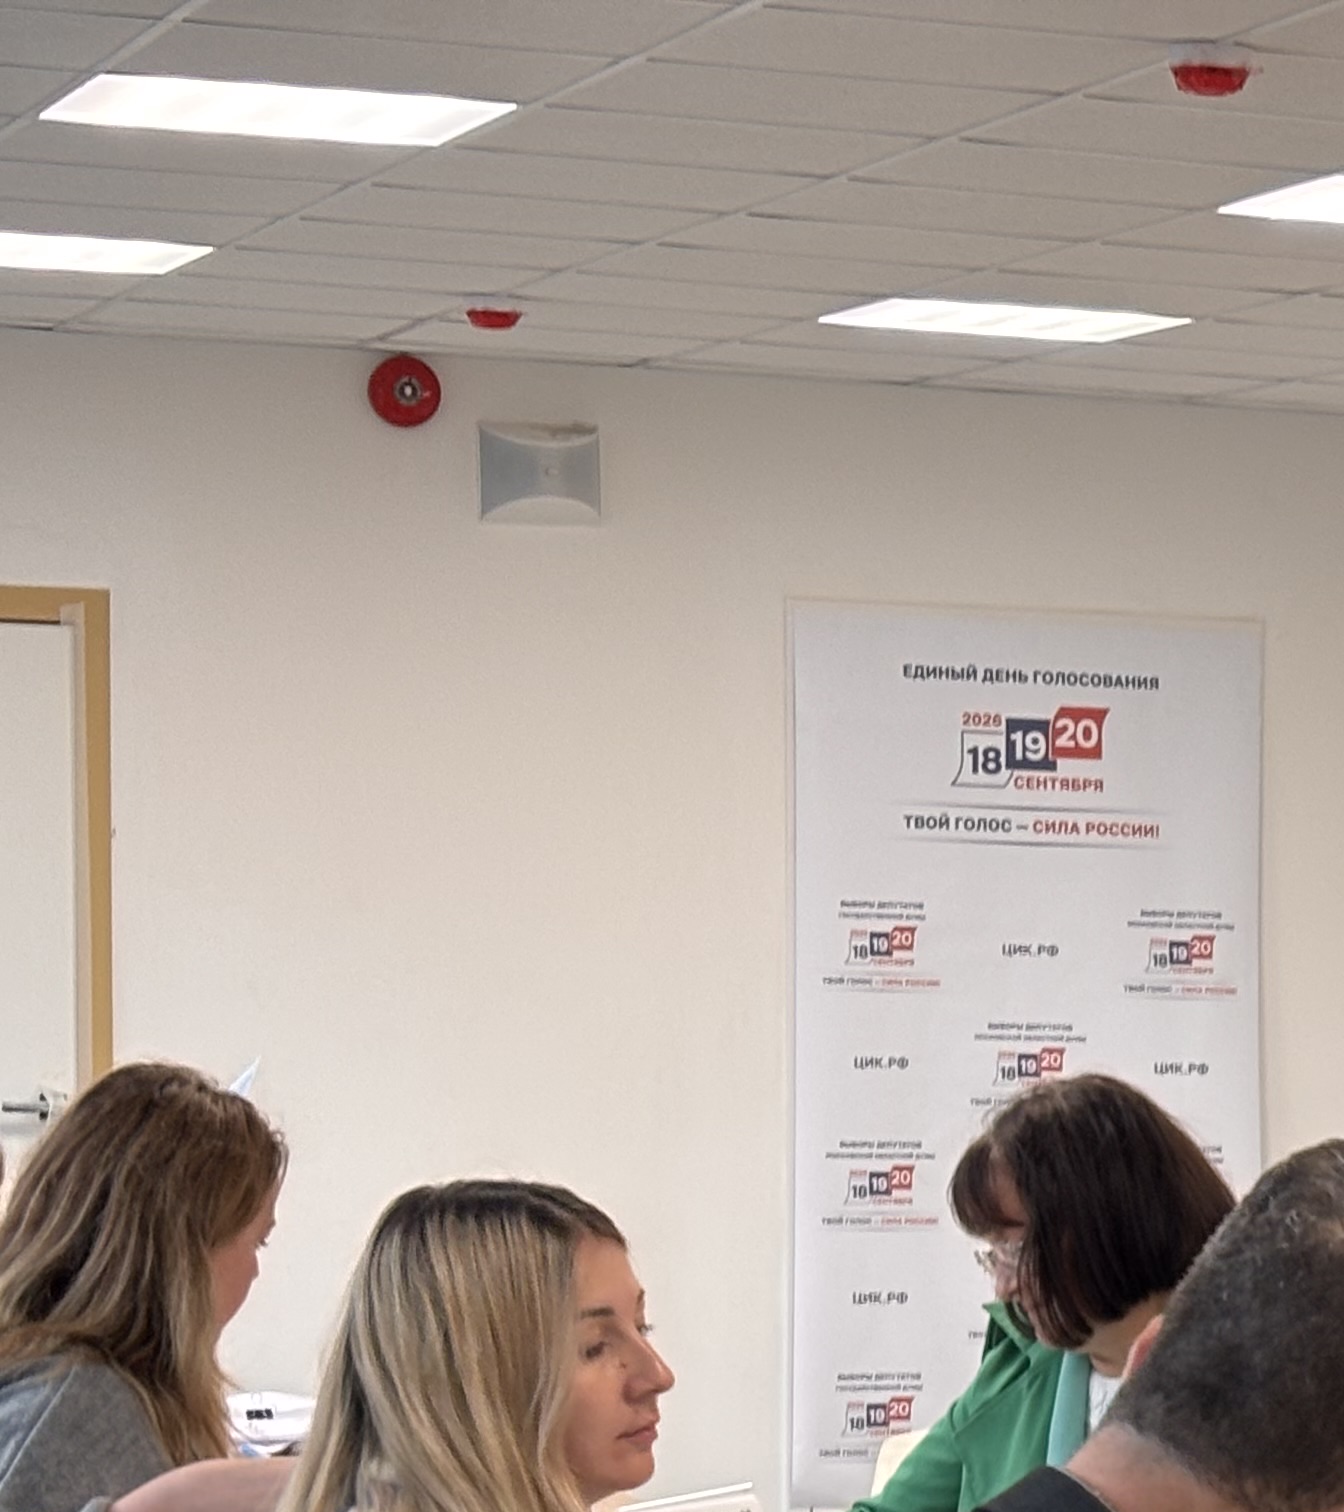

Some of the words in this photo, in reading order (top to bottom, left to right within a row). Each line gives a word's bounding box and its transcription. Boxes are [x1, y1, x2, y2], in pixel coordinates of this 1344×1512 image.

[902, 663, 978, 683] ЕДИНЫЙ
[981, 667, 1029, 685] ДЕНЬ
[1032, 670, 1160, 691] ГОЛОСОВАНИЯ
[961, 711, 1003, 728] 2026
[966, 745, 1002, 775] 18
[1010, 730, 1046, 761] 19
[1055, 718, 1099, 748] 20
[1013, 775, 1104, 793] СЕНТЯБРЯ
[903, 813, 950, 831] ТВОЙ
[954, 817, 1012, 834] ГОЛОС
[1032, 819, 1080, 835] СИЛА
[1085, 821, 1160, 838] РОССИИ!
[892, 932, 912, 947] 20
[1191, 941, 1211, 955] 20
[854, 1056, 909, 1070] ЦИК.РФ
[1041, 1052, 1061, 1067] 20
[1154, 1062, 1209, 1076] ЦИК.РФ
[891, 1170, 910, 1185] 20
[889, 1402, 909, 1417] 20
